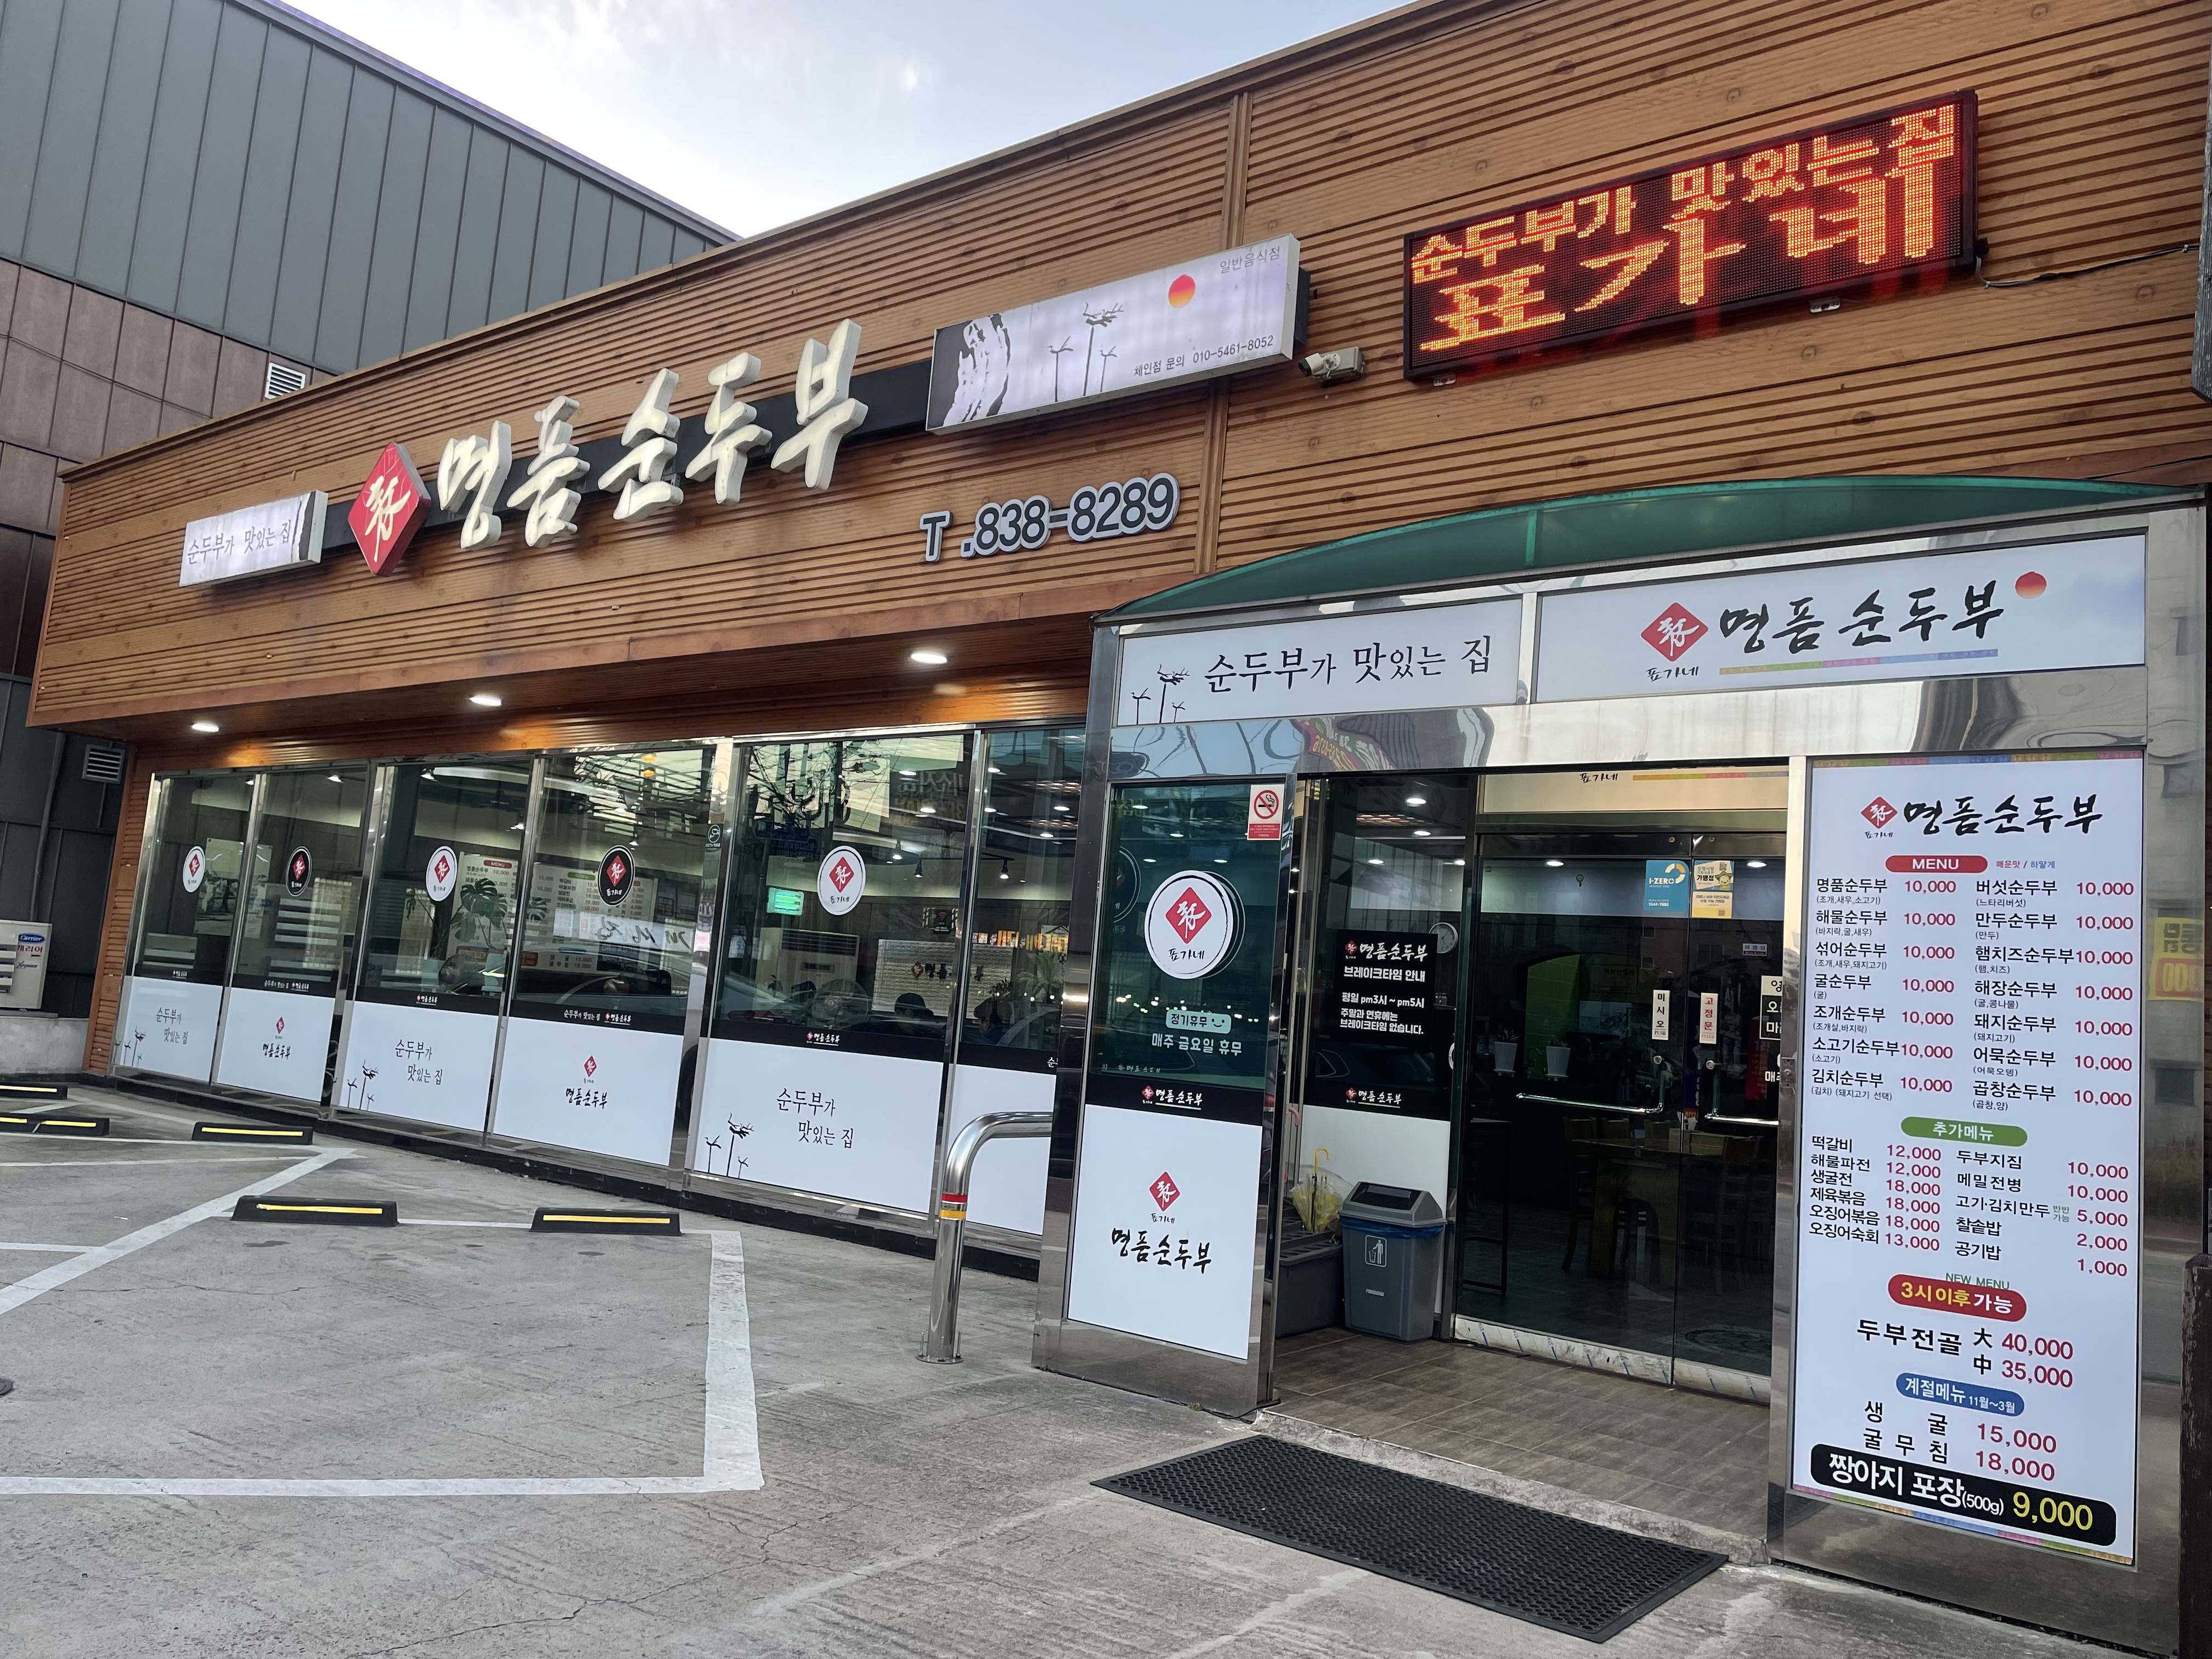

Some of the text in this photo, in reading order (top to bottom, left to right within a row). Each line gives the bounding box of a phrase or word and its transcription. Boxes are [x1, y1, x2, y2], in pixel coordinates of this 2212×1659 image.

[1411, 104, 1955, 284] 순두부가 맛있는 집
[1221, 246, 1279, 273] 일반음식점
[1419, 161, 1934, 350] 표가네
[1135, 335, 1273, 376] 체인점 문의 010-5461-8052
[188, 520, 291, 565] 순두부가 맛있는 집
[1205, 635, 1490, 692] 순두부가 맛있는 집
[1646, 667, 1699, 681] 표가네
[1904, 794, 2102, 836] 명품순두부
[1912, 859, 1959, 869] MENU
[1818, 878, 1956, 894] 명품순두부 10,000
[1977, 880, 2134, 896] 버섯순두부 10,000
[1817, 895, 1880, 905] (조개,새우,소고기)
[1977, 898, 2025, 907] (느타리버섯)
[1816, 910, 1955, 926] 해물순두부 10,000
[1976, 913, 2133, 930] 만두순두부 10,000
[1816, 927, 1871, 936] (바지락,굴,새우)
[1976, 931, 1999, 940] (만두)
[1169, 949, 1204, 961] 표가네
[1360, 943, 1427, 962] 명품순두부
[1816, 942, 1955, 960] 섞어순두부 10,000
[1976, 946, 2133, 965] 햄치즈순두부 10,000
[1344, 966, 1425, 982] 브레이크타임 안내
[1815, 959, 1887, 969] (조개,새우,돼지고기)
[1975, 964, 2010, 974] (햄,치즈)
[1815, 974, 1954, 992] 굴순두부 10,000
[1975, 980, 2132, 1000] 해장순두부 10,000
[1342, 992, 1424, 1008] 평일 pm3시 pm5시
[1814, 991, 1826, 999] (굴)
[1974, 998, 2018, 1009] (굴,콩나물)
[156, 1007, 181, 1024] 순두부가
[1171, 1014, 1207, 1028] 정기휴무
[1341, 1008, 1398, 1021] 주말과 연휴에는
[1814, 1006, 1953, 1025] 조개순두부 10,000
[1340, 1019, 1423, 1034] 브레이크타임 없습니다.
[1813, 1023, 1867, 1034] (조개살,바지락)
[1974, 1014, 2132, 1036] 돼지순두부 10,000
[164, 1028, 189, 1045] 맛있는 집
[1152, 1033, 1242, 1056] 매주 금요일 휴무
[1974, 1032, 2015, 1043] (돼지고기)
[395, 1039, 432, 1060] 순두부가
[1813, 1037, 1953, 1059] 소고기순두부 10,000
[1813, 1054, 1840, 1064] (소고기)
[1974, 1047, 2132, 1071] 어묵순두부 10,000
[408, 1064, 442, 1085] 맛있는 집
[1813, 1069, 1952, 1092] 김치순두부 10,000
[1973, 1066, 2018, 1076] (어묵오뎅)
[566, 1088, 607, 1109] 명품순두부
[777, 1088, 836, 1116] 순두부가
[1812, 1086, 1892, 1101] (김치) (돼지고기 선택)
[1973, 1081, 2131, 1106] 곱창순두부 10,000
[1973, 1099, 2007, 1111] (곱창,양)
[799, 1120, 853, 1149] 맛있는 집
[1932, 1121, 1994, 1141] 추가메뉴
[1813, 1136, 1941, 1160] 떡갈비 12,000
[1811, 1154, 1940, 1178] 해물파전 12,000
[1957, 1150, 2128, 1179] 두부지짐 10,000
[1811, 1170, 1940, 1195] 생굴전 18,000
[1958, 1173, 2128, 1203] 메밀전병 10,000
[1810, 1188, 1940, 1214] 제육볶음 18,000
[1810, 1205, 1939, 1232] 오징어볶음 18,000
[2078, 1210, 2128, 1226] 5,000
[1809, 1222, 1939, 1251] 오징어숙회 13,000
[1956, 1217, 2127, 1251] 찰솥밥 2,000
[1112, 1228, 1211, 1274] 명품순두부
[1955, 1242, 2127, 1276] 공기밥 1,000
[1946, 1273, 2009, 1289] NEW MENU
[1857, 1319, 1961, 1356] 두부전골
[1973, 1328, 2073, 1359] 大 40,000
[1974, 1354, 2073, 1387] 中 35,000
[1905, 1377, 1966, 1404] 계절메뉴
[1978, 1424, 2056, 1453] 15,000
[1976, 1451, 2055, 1481] 18,000
[1829, 1454, 1903, 1496] 짱아지
[2013, 1492, 2092, 1530] 9,000
